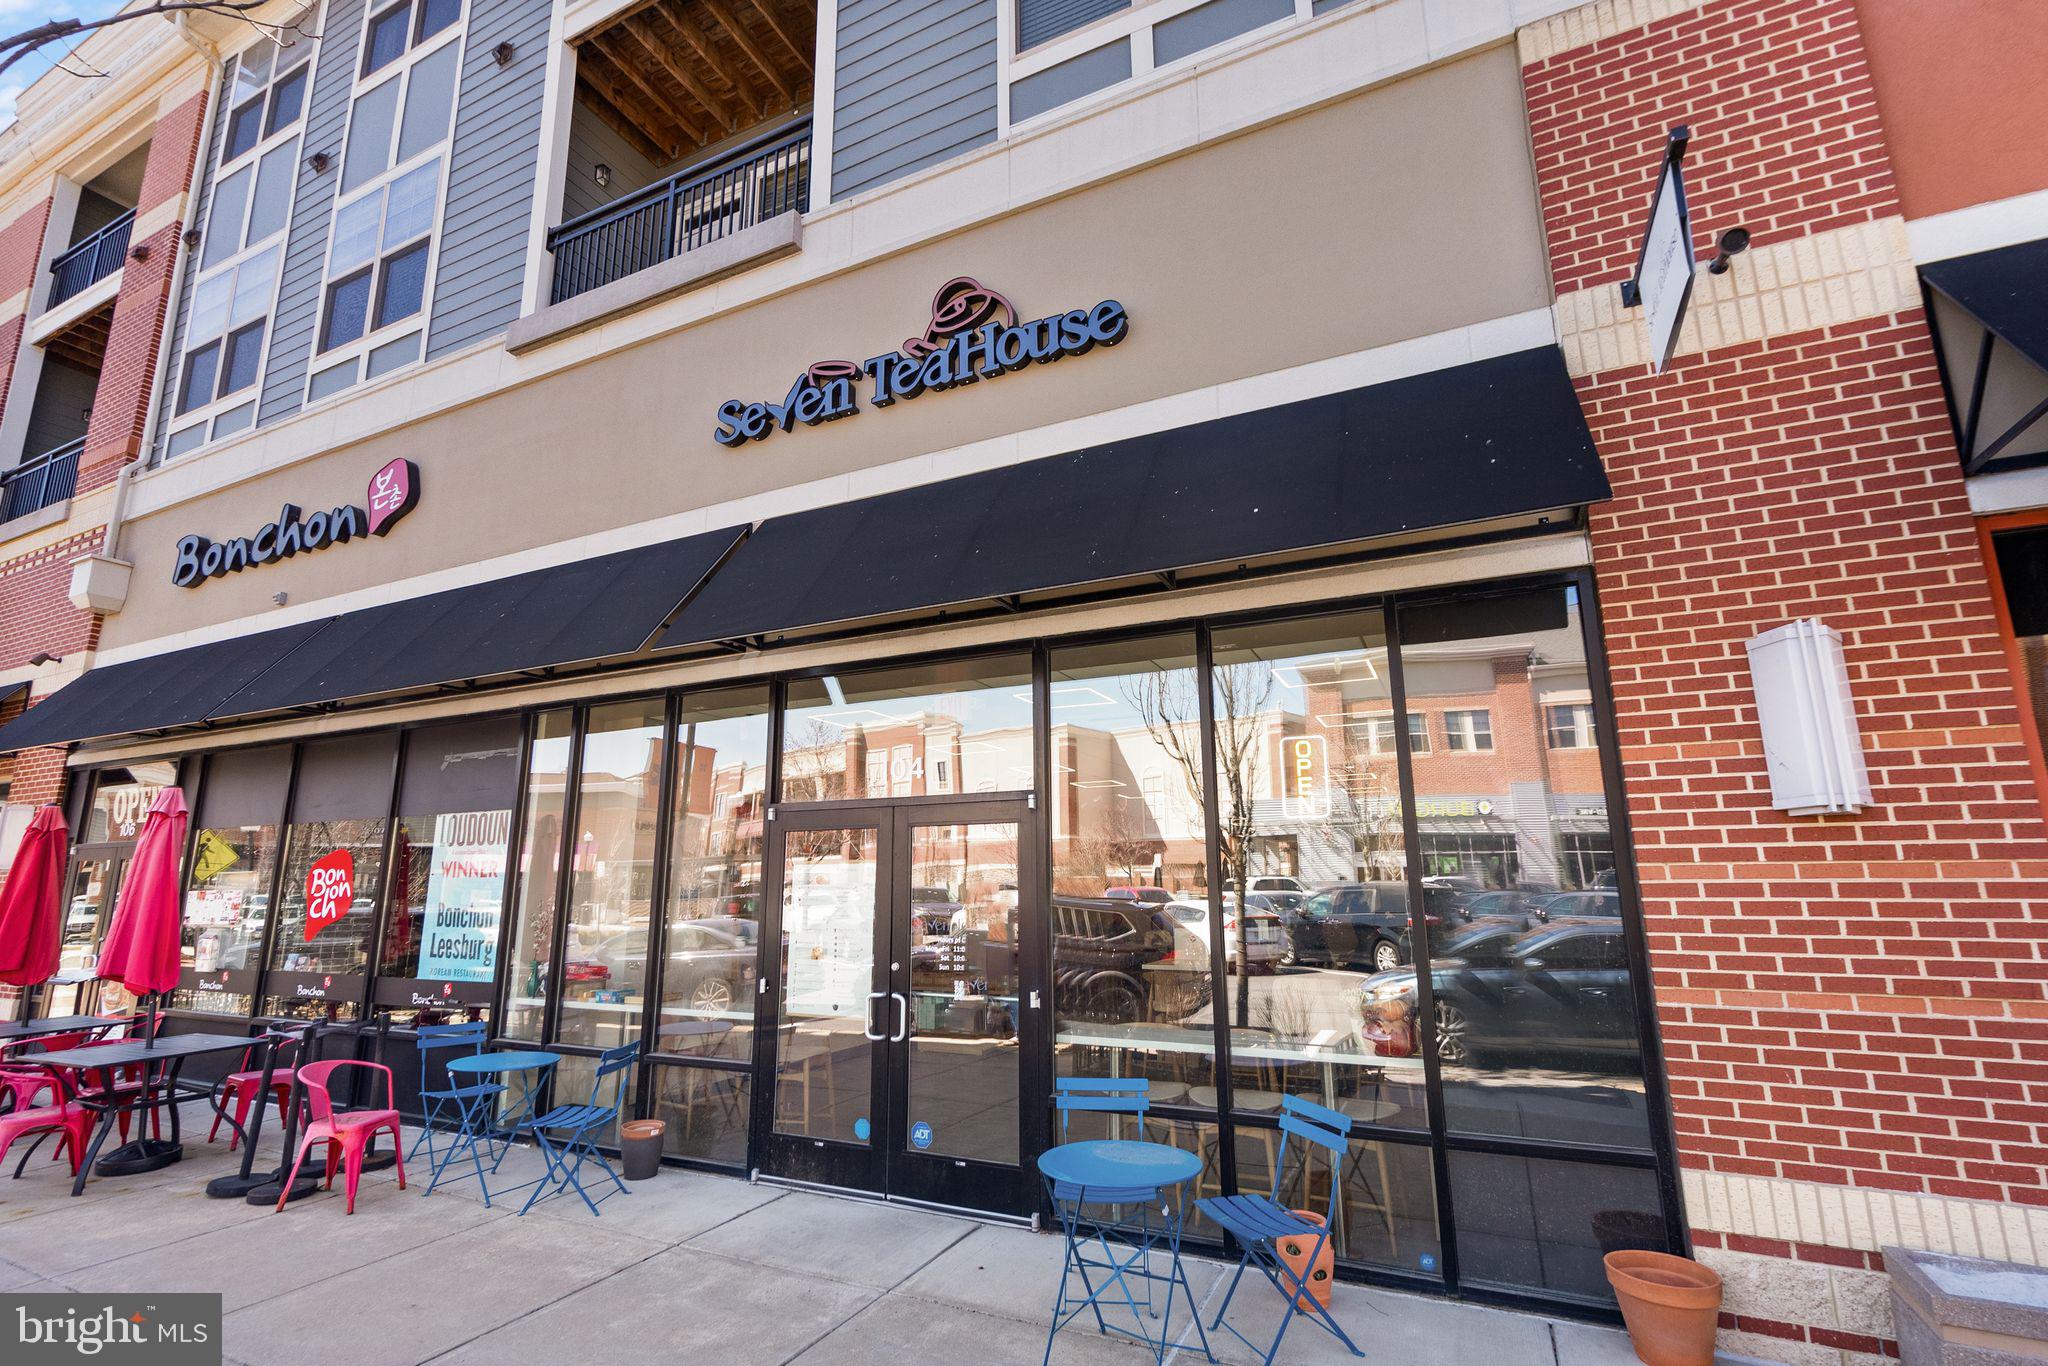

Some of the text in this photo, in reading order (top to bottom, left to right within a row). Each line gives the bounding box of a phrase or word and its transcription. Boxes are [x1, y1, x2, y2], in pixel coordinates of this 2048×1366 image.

[172, 503, 359, 588] Bonchon
[1295, 740, 1315, 817] OPEN
[114, 787, 158, 825] OPE
[119, 823, 136, 837] 106
[439, 811, 509, 847] LOUDOUN
[441, 860, 498, 878] WINNER
[311, 868, 346, 897] Bon
[436, 902, 494, 928] Bonchon
[429, 932, 495, 967] Leesburg
[938, 963, 950, 971] Sun
[199, 979, 223, 990] Bonchon
[297, 984, 325, 997] Bonchon
[914, 1129, 930, 1140] ADT
